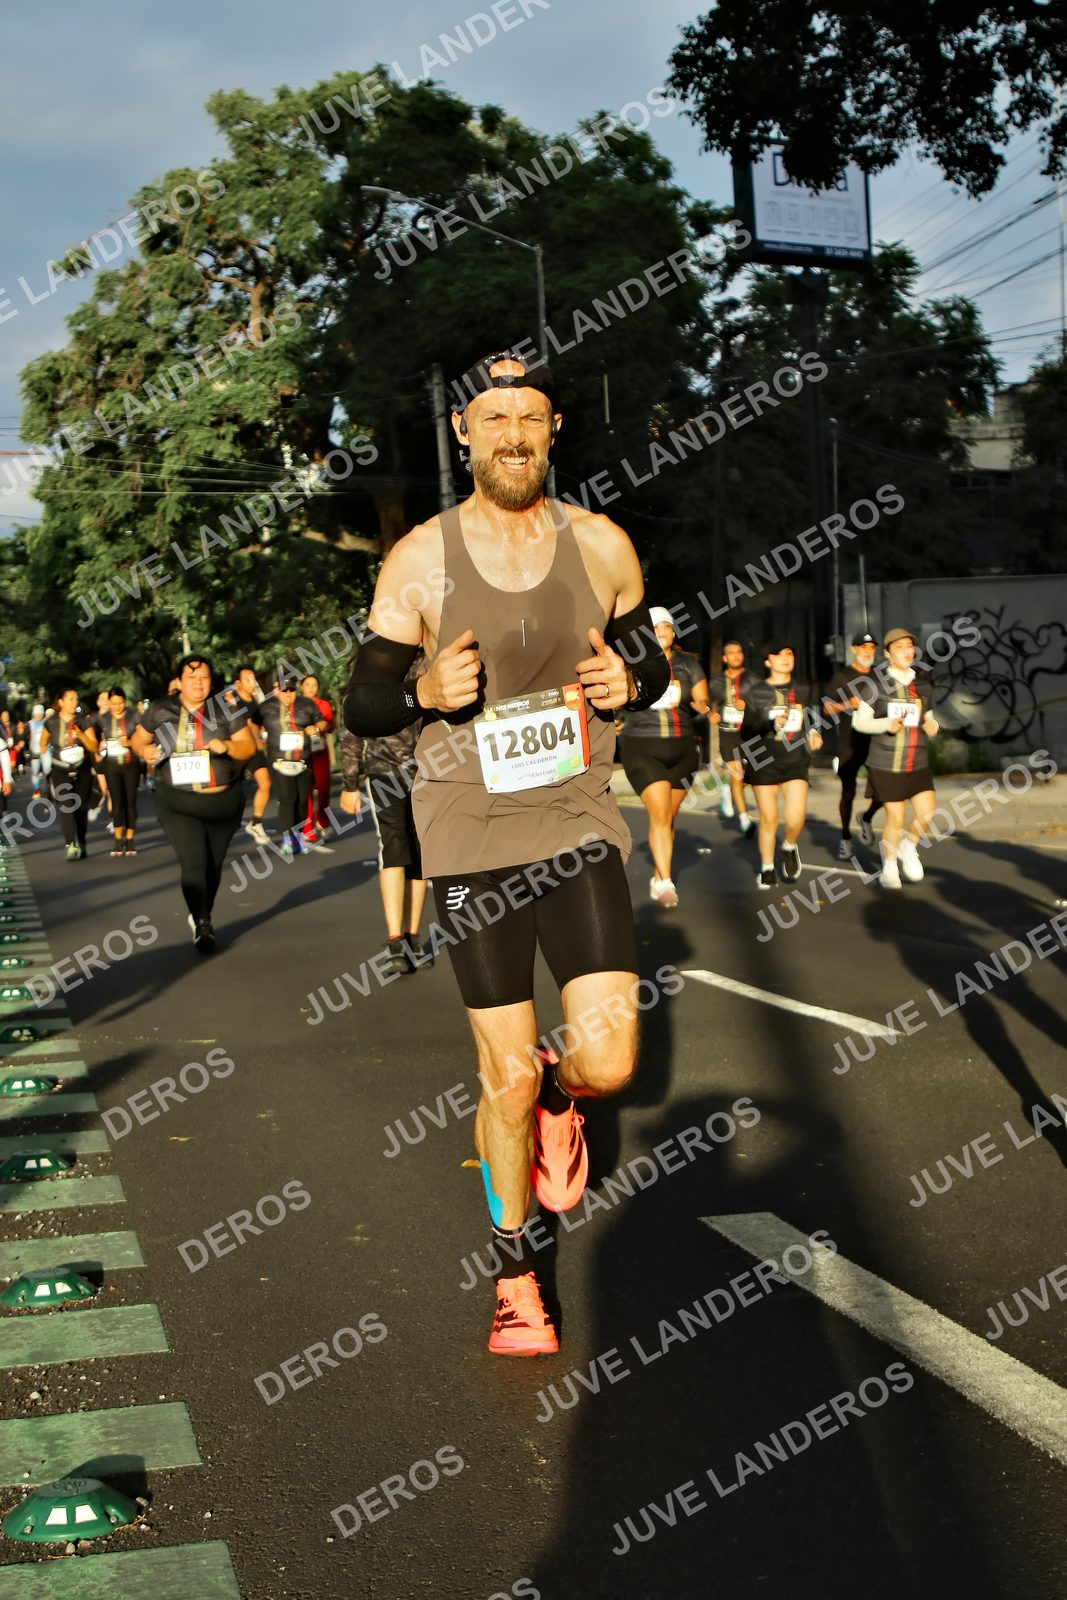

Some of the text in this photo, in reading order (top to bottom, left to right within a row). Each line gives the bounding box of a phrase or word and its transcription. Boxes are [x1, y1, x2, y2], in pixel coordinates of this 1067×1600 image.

[483, 717, 576, 762] 12804
[176, 761, 200, 772] 5170
[525, 754, 558, 767] CALDERÓN
